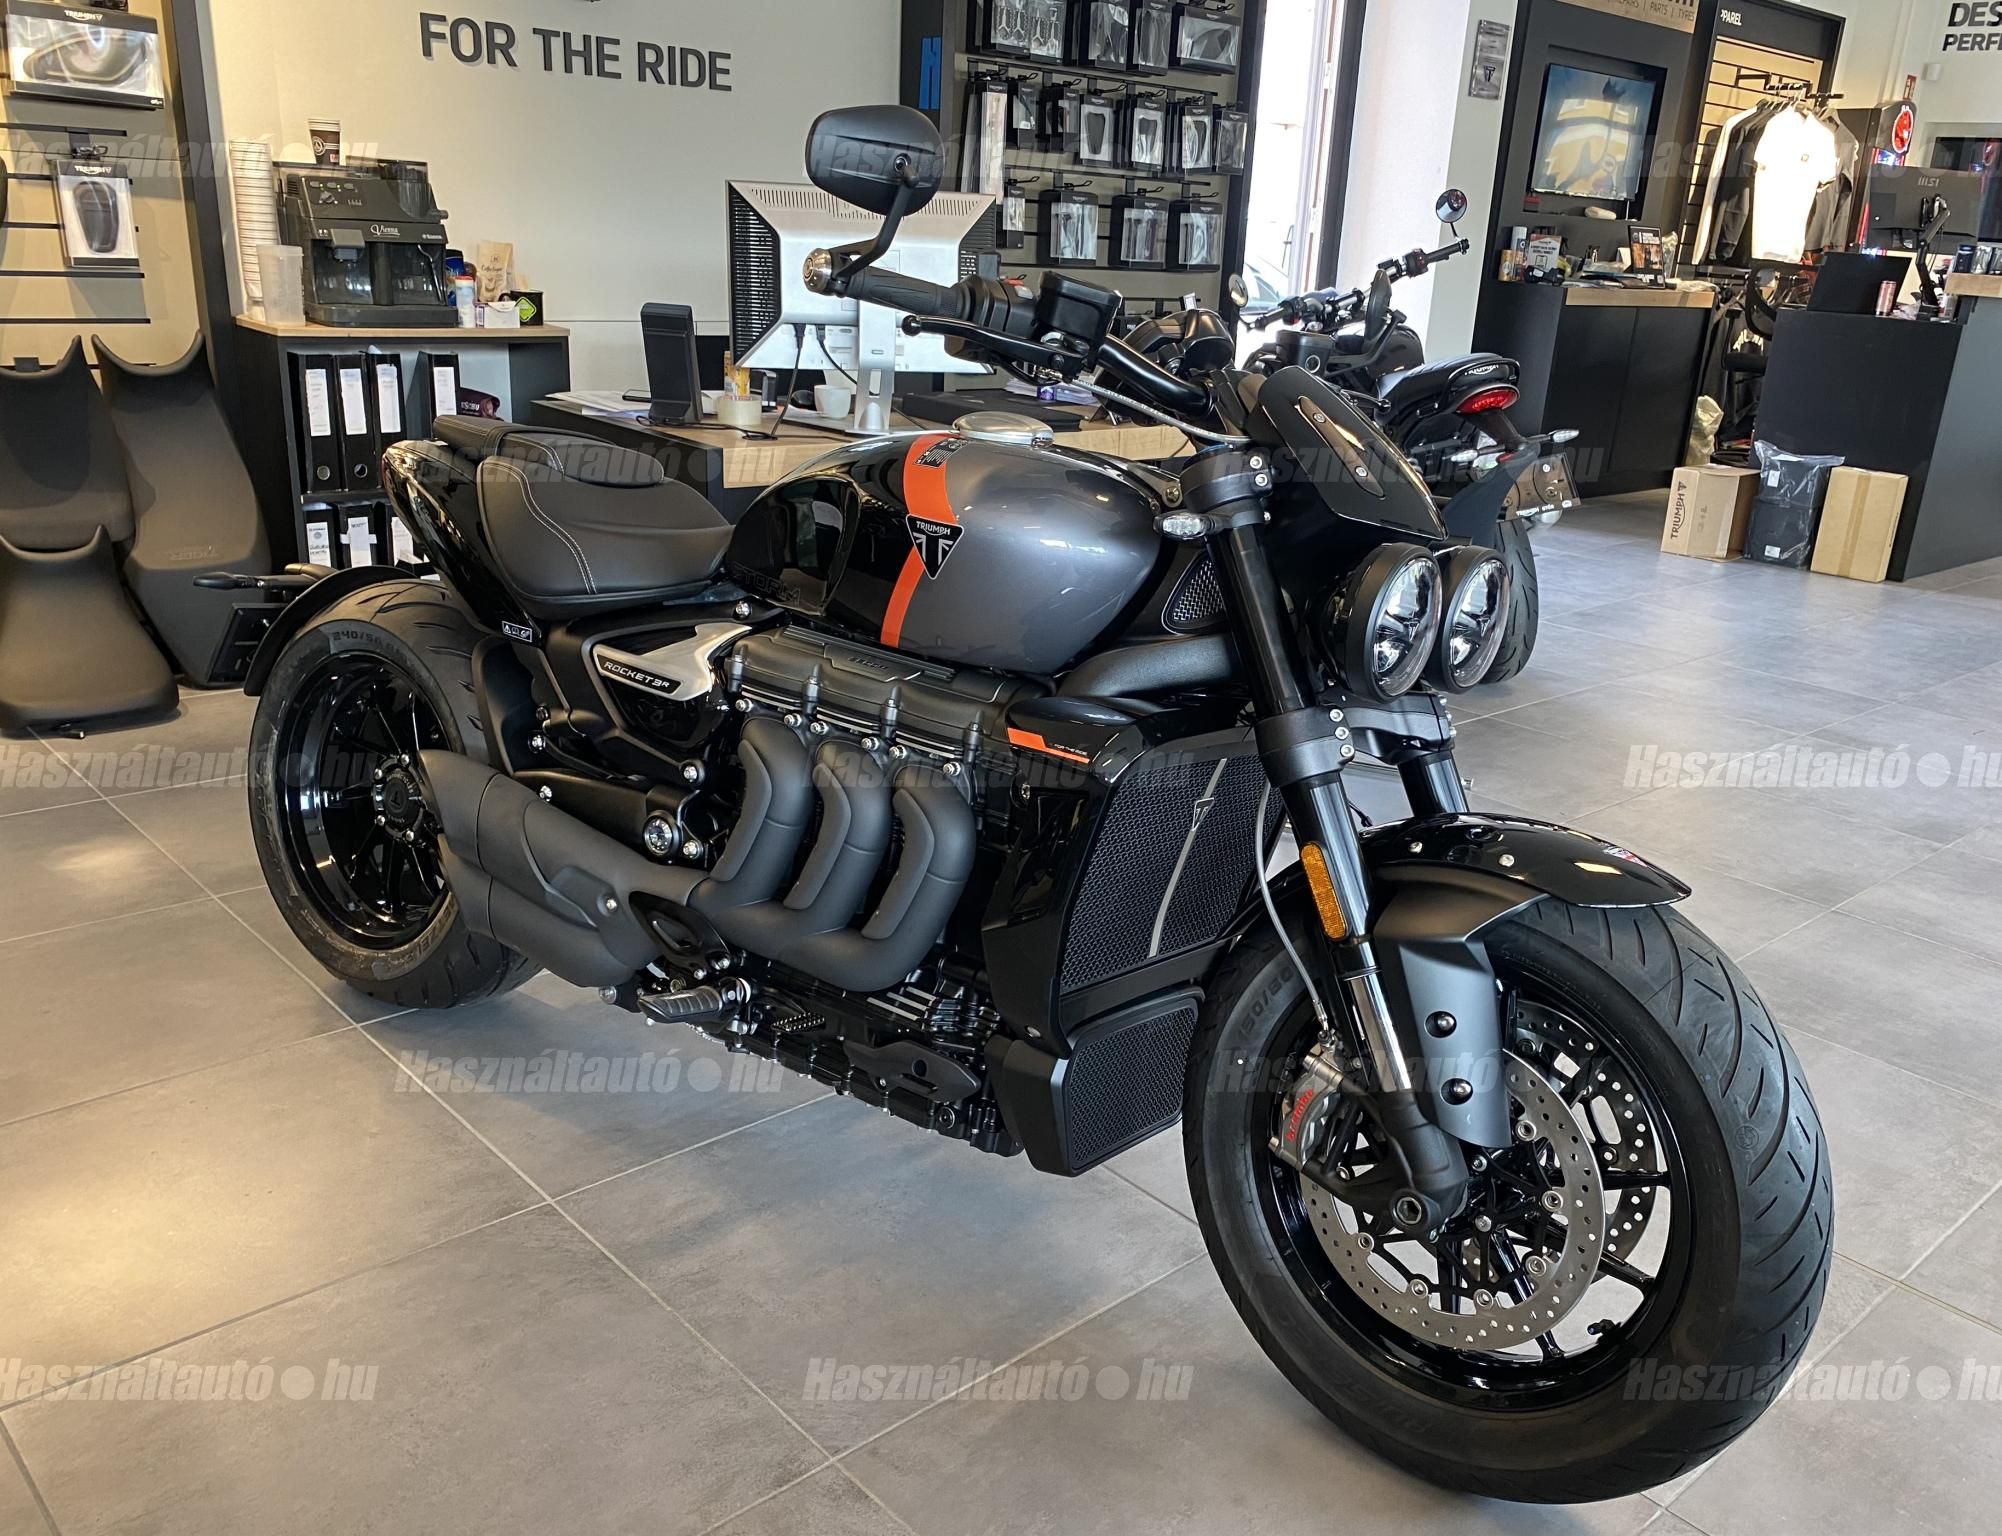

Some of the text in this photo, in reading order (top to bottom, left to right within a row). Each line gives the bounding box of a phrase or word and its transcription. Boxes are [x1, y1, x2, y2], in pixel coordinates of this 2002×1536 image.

[1948, 1, 2002, 27] DES
[419, 12, 733, 92] FOR THE RIDE
[916, 519, 951, 536] TRIUMPH
[1669, 492, 1686, 540] TRIUMPH
[1285, 1089, 1313, 1141] brembo
